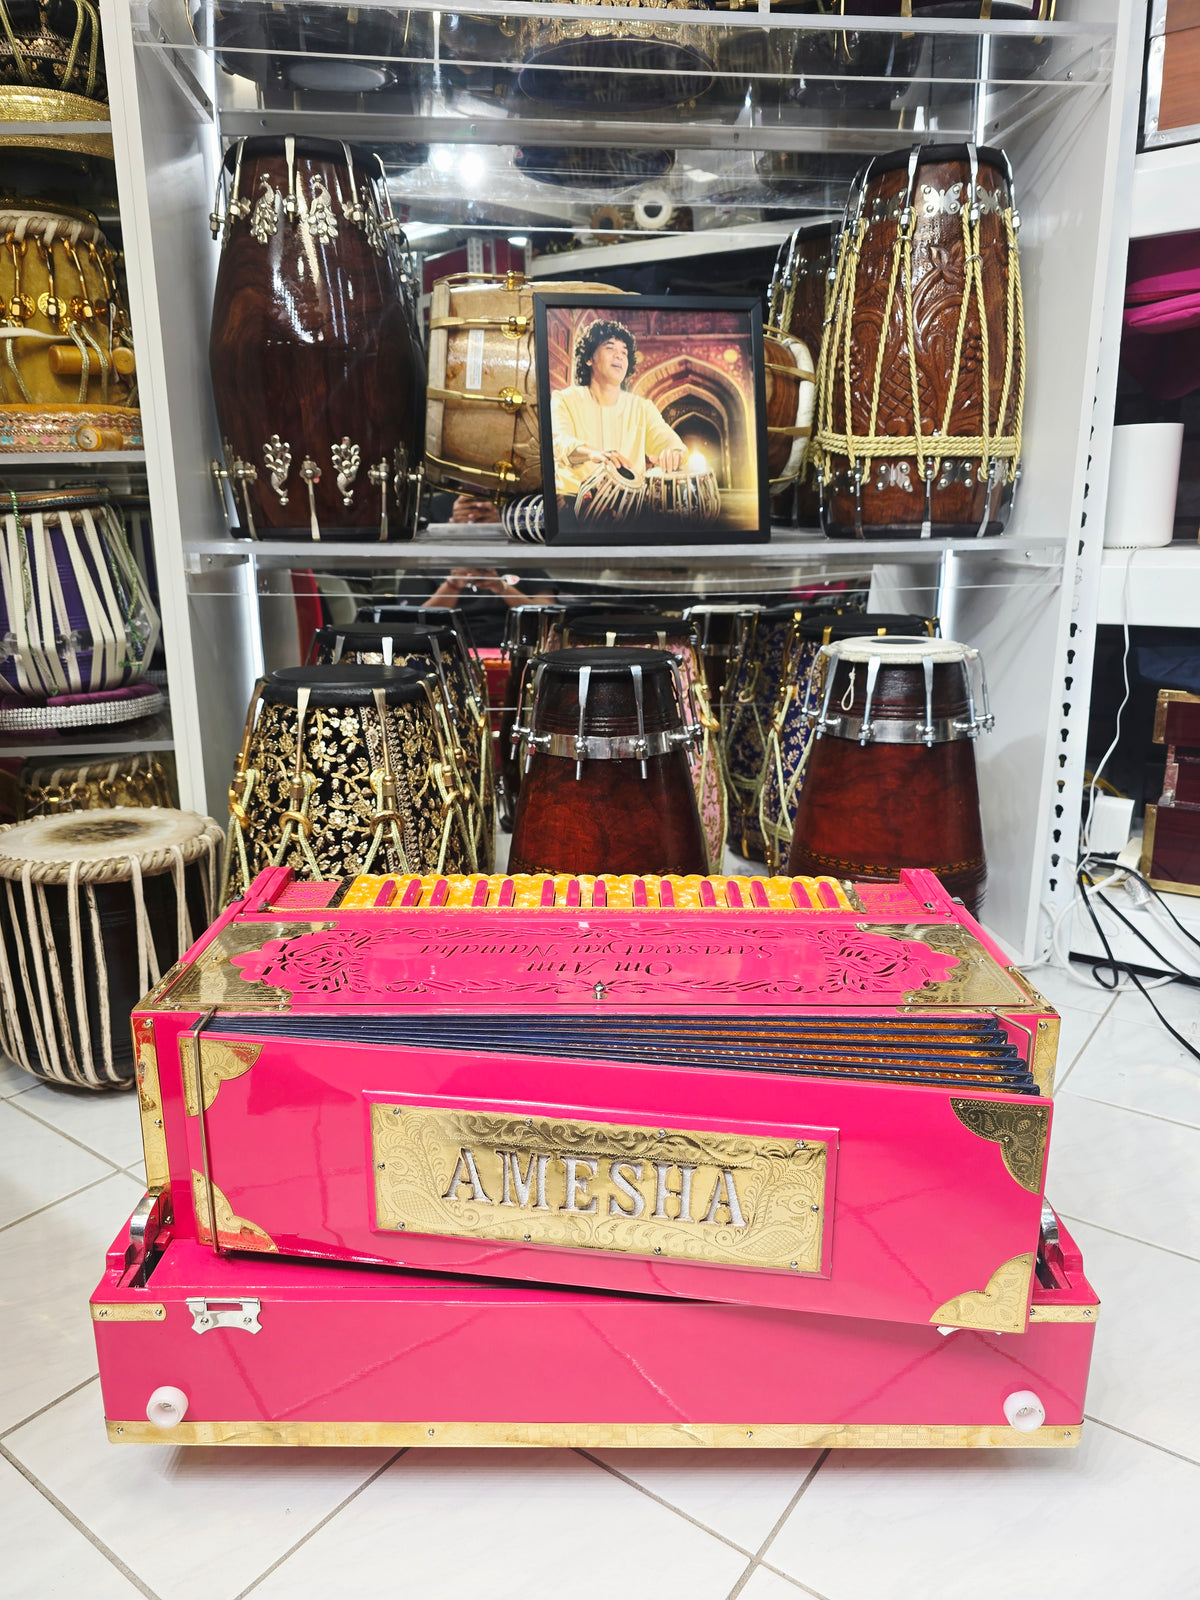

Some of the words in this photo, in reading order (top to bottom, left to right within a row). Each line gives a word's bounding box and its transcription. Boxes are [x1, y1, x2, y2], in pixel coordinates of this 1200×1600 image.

[419, 943, 560, 959] Namaha
[526, 959, 605, 977] Aim
[614, 960, 673, 977] Om
[441, 1147, 750, 1227] AMESHA
